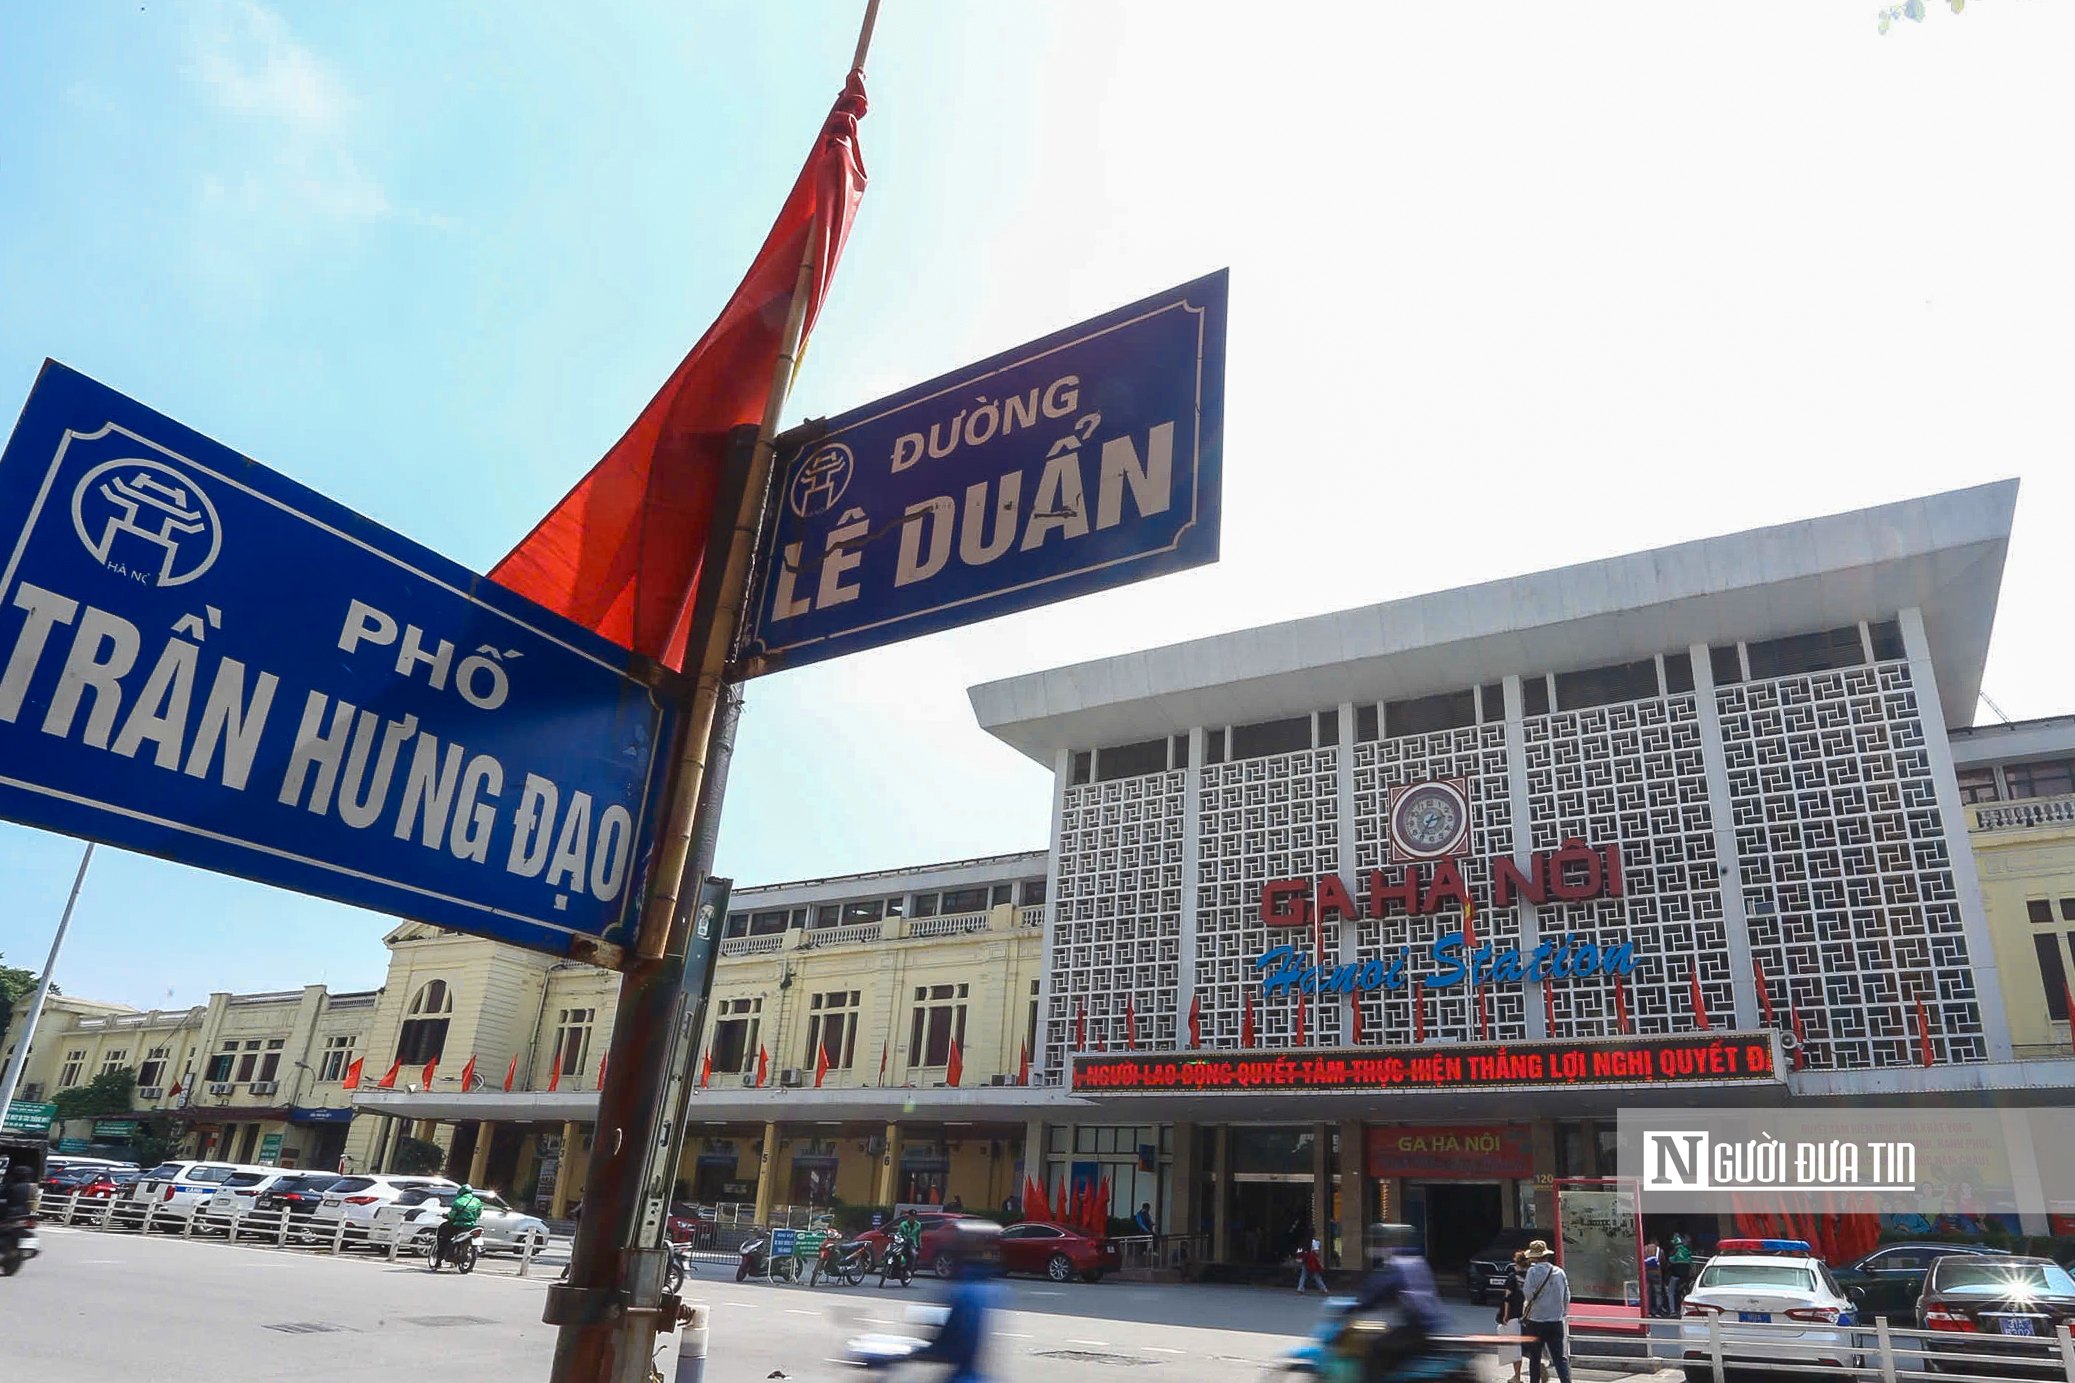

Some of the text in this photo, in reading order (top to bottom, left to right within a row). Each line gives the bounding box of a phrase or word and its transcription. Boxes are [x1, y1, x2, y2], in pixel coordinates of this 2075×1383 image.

[890, 374, 1080, 474] ĐƯỜNG
[770, 412, 1175, 623] LÊ DUẨN
[338, 598, 525, 710] PHỐ
[0, 580, 633, 911] TRẦN HƯNG ĐẠO
[1260, 837, 1624, 927] GA HÀ NỘI
[1255, 932, 1640, 998] Hanoi Station
[1237, 1055, 1297, 1087] QUYẾT
[1410, 1053, 1462, 1087] HIỆN
[1467, 1045, 1543, 1080] THẮNG
[1550, 1050, 1587, 1083] LỢI
[1593, 1050, 1652, 1081] NGHỊ
[1659, 1039, 1739, 1077] QUYẾT
[762, 1153, 768, 1164] 5
[1398, 1132, 1500, 1154] GA HÀ NỘI
[1536, 1173, 1554, 1184] 120
